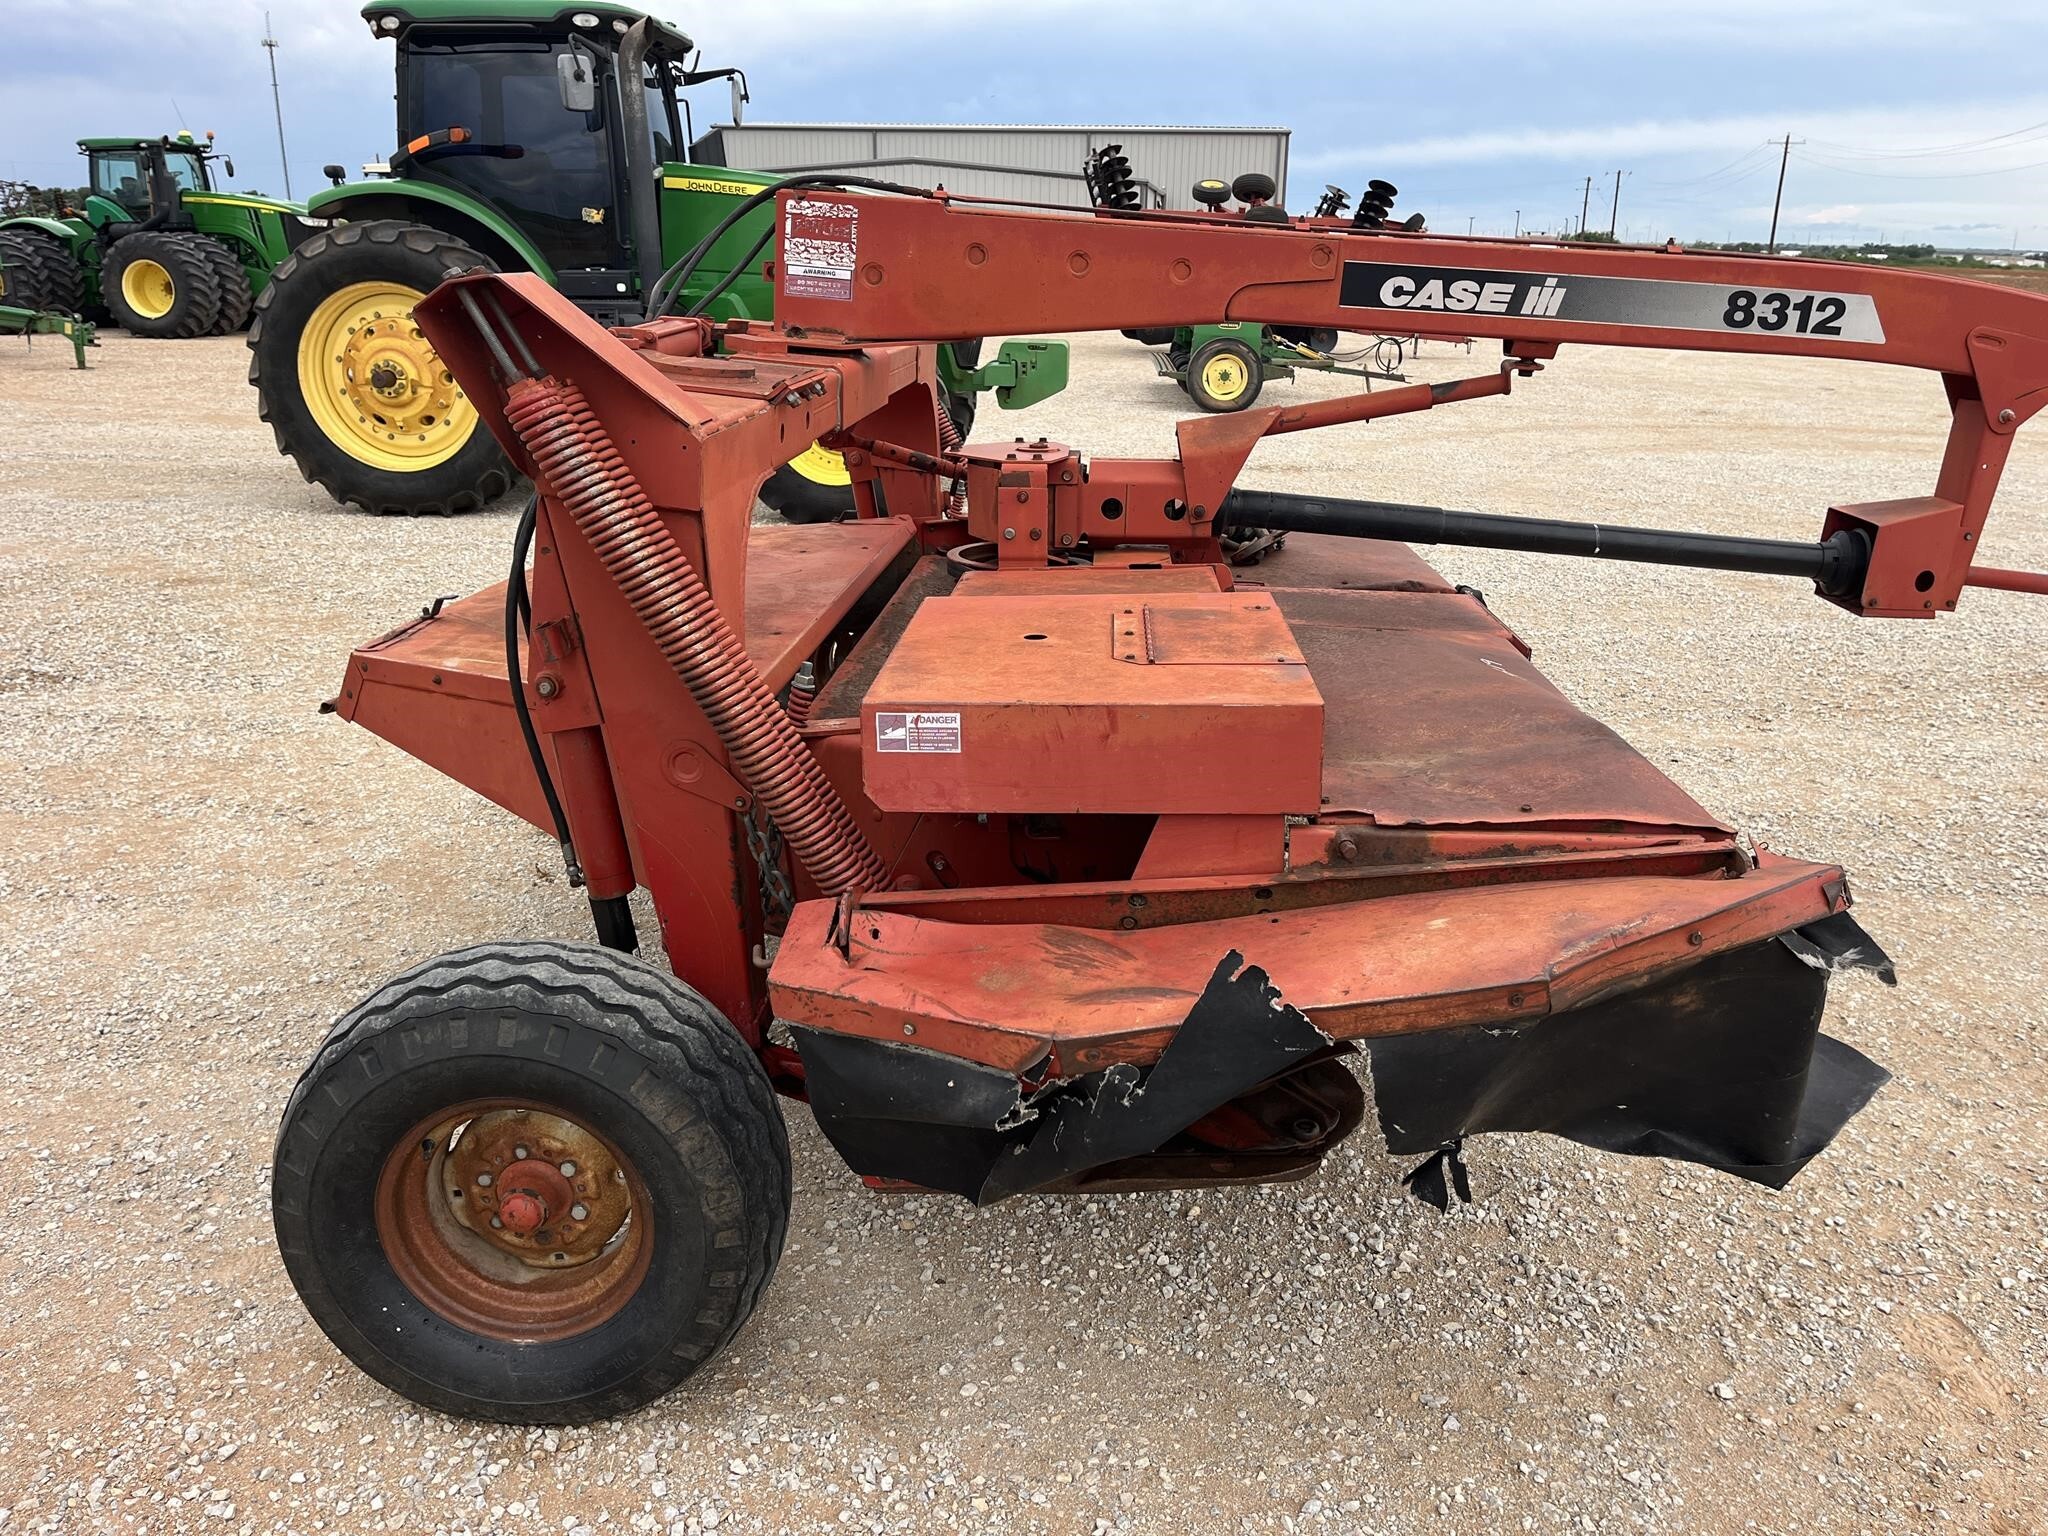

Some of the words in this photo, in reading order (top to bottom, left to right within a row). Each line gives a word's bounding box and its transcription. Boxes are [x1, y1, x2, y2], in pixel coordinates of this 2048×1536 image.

[686, 180, 712, 192] JOHN
[714, 182, 747, 194] DEERE
[808, 268, 836, 277] WARNING
[1379, 275, 1516, 313] CASE
[1723, 290, 1846, 335] 8312
[919, 716, 957, 724] DANGER
